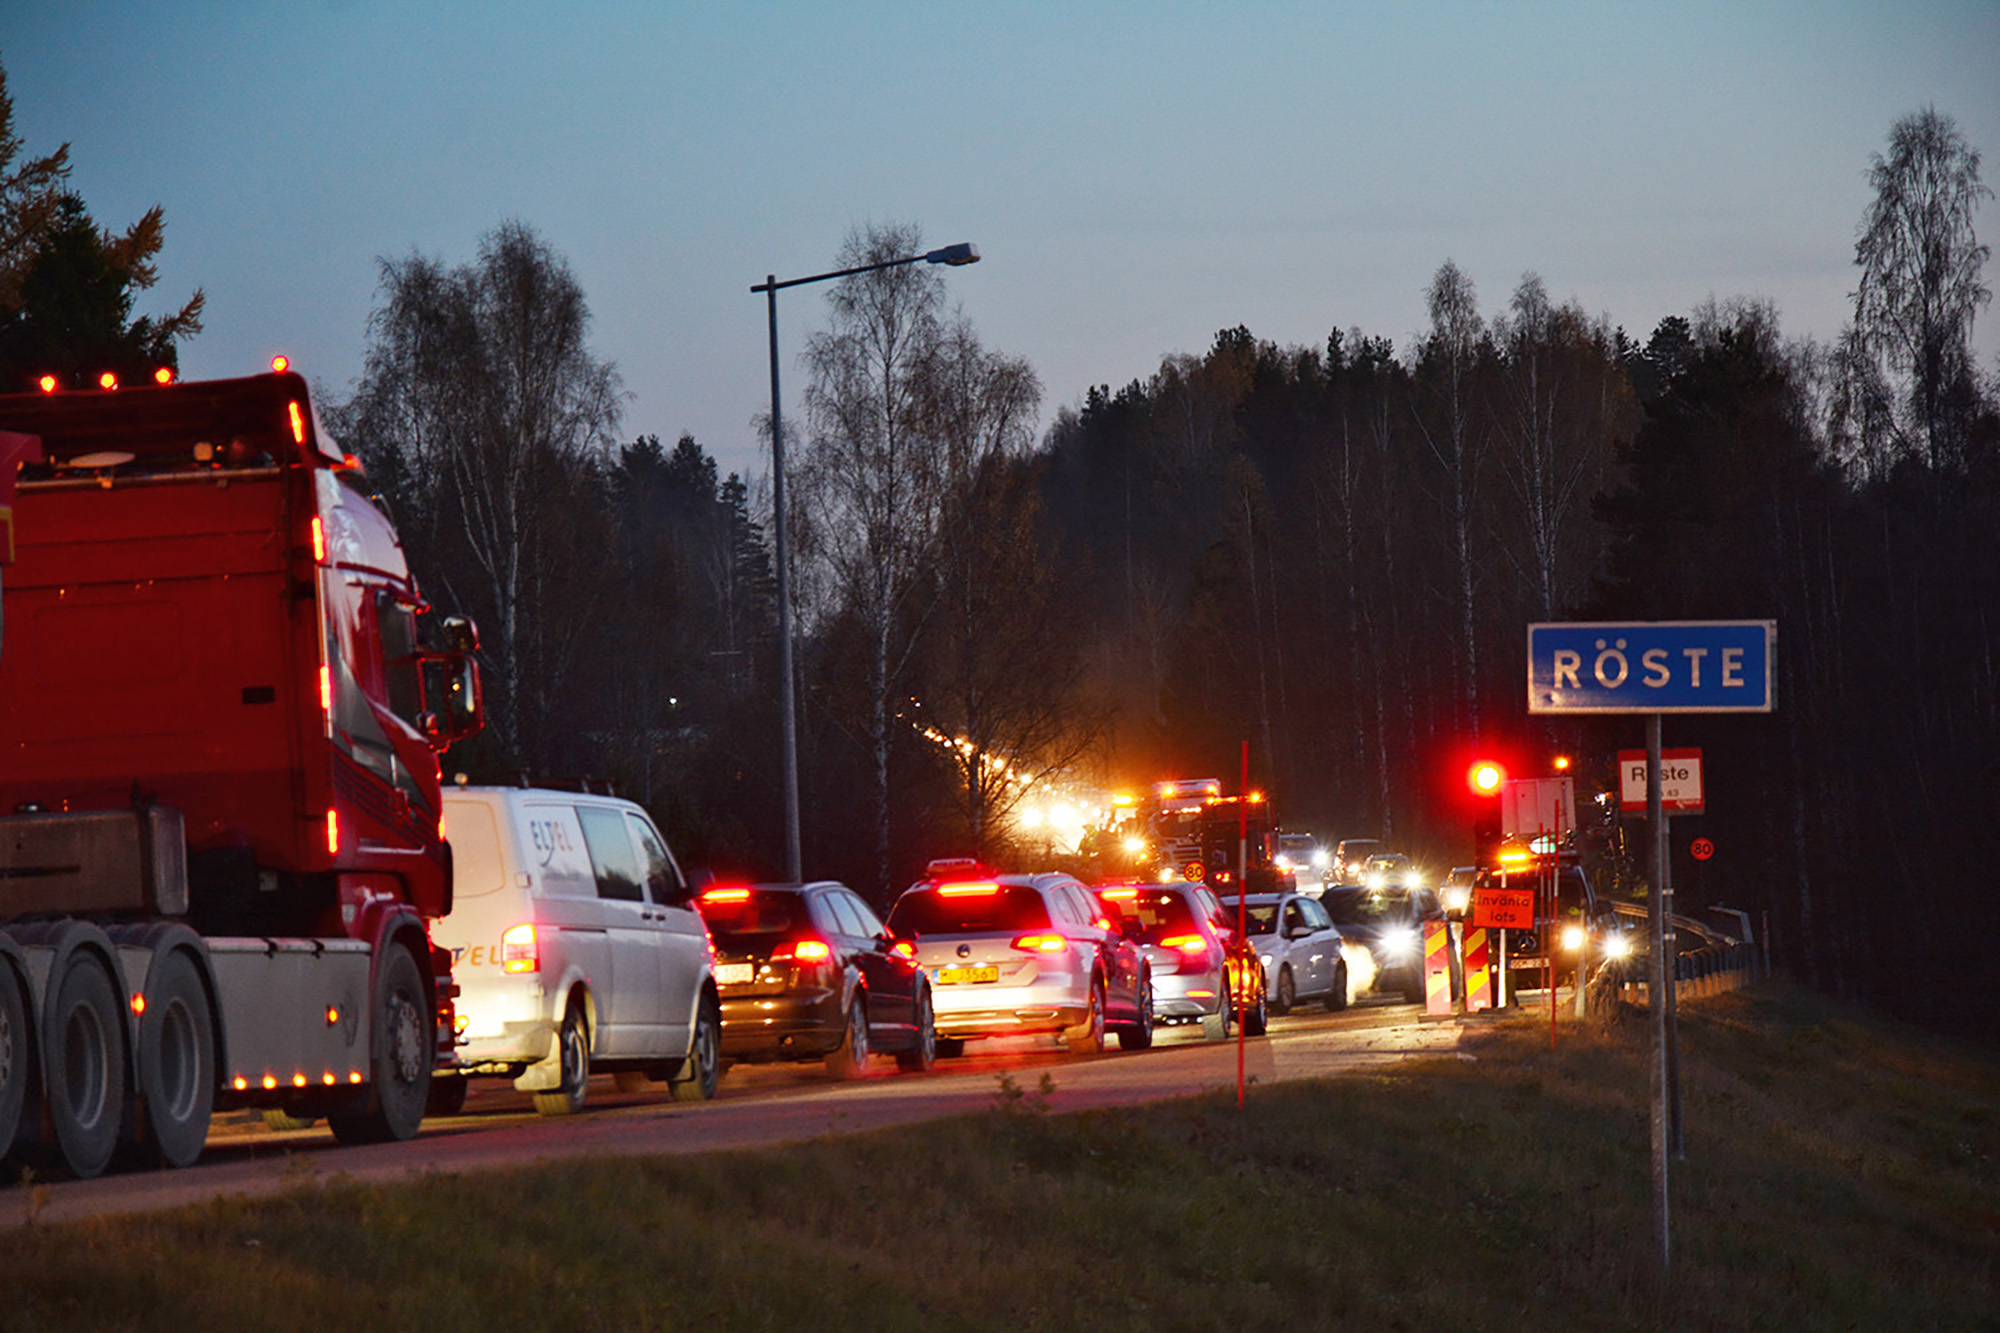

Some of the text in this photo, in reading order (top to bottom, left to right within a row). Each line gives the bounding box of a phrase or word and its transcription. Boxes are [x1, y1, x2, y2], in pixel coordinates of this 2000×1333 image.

[1554, 638, 1745, 688] RÖSTE
[1632, 766, 1689, 781] Rste
[1694, 843, 1711, 855] 80
[1186, 866, 1202, 878] 80
[1490, 910, 1517, 922] lots
